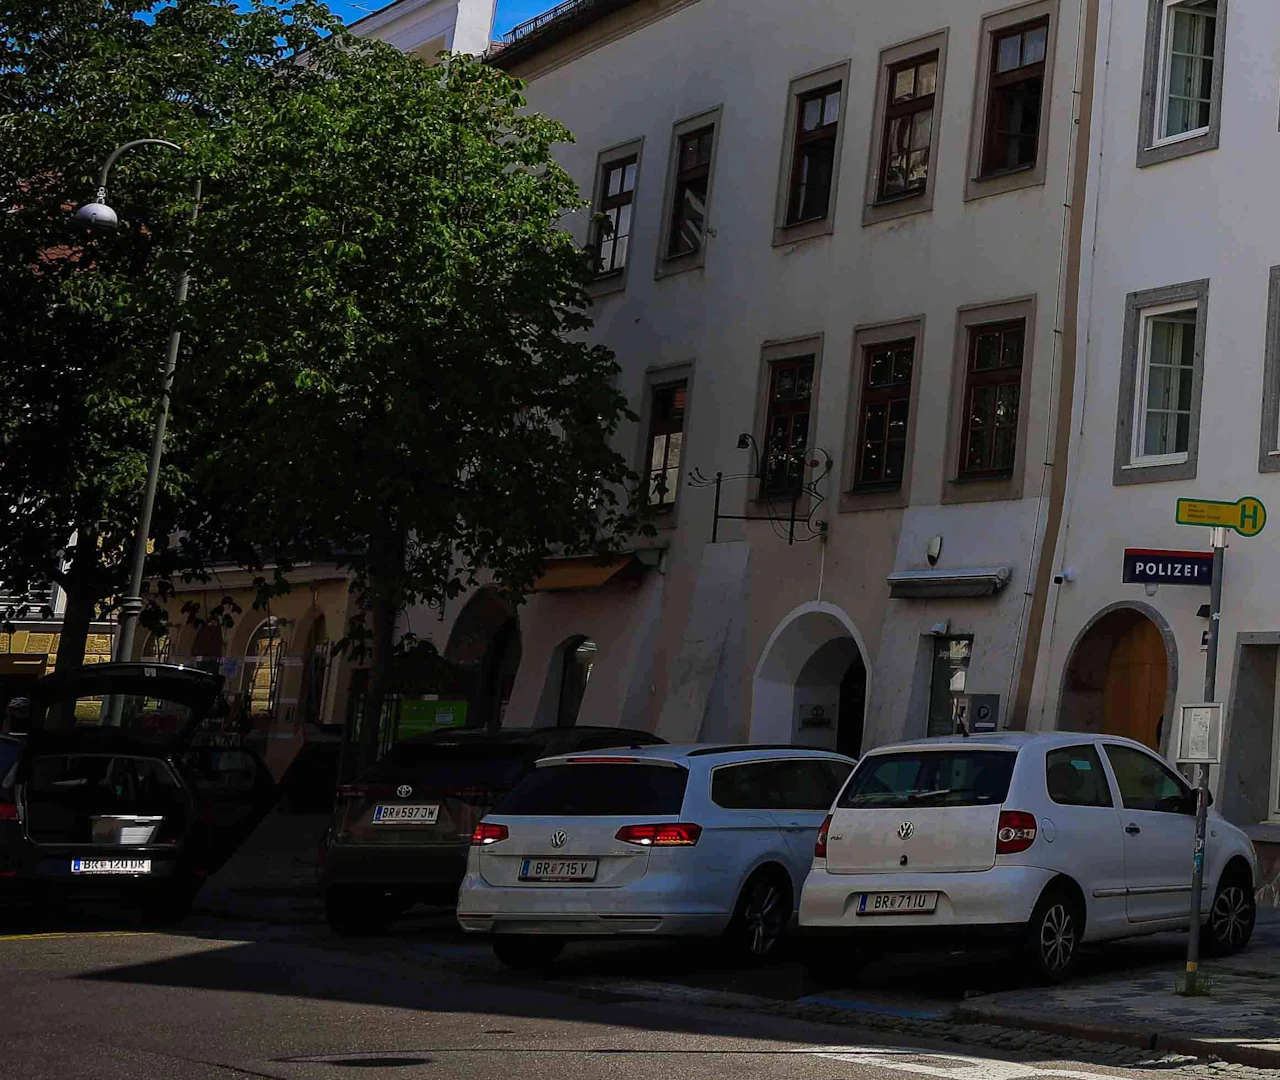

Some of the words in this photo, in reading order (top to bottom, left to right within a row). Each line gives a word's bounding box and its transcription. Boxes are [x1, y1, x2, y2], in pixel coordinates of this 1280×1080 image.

[1241, 504, 1258, 529] H
[1135, 562, 1199, 577] POLIZEI
[382, 807, 395, 818] BR
[401, 807, 420, 818] 597
[84, 859, 99, 869] BR
[535, 862, 550, 875] BR
[558, 862, 578, 875] 715
[581, 862, 588, 875] V
[874, 895, 889, 909] BR
